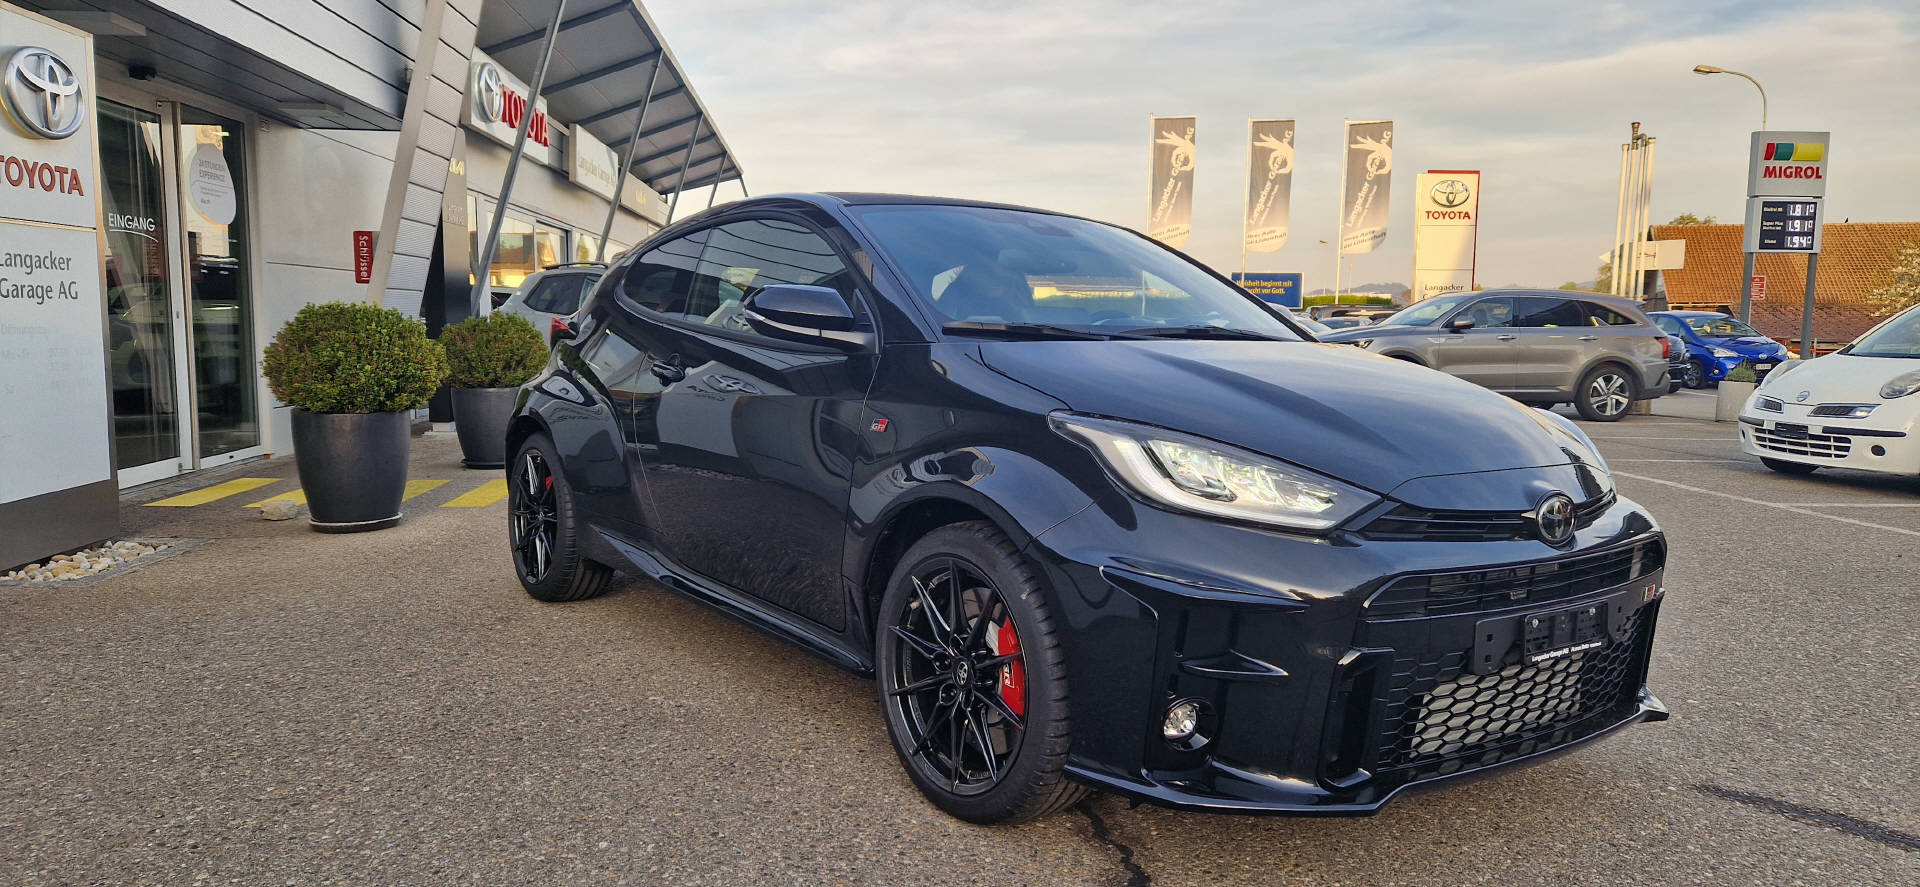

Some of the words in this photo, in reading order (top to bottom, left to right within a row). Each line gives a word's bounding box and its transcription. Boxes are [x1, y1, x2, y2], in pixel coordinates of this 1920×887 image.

[1762, 165, 1822, 180] MIGROL
[1152, 178, 1175, 223] Langacker
[1249, 180, 1272, 225] Langacker
[1345, 181, 1370, 227] Langacker
[108, 212, 156, 232] EINGANG
[1425, 211, 1471, 220] TOYOTA
[0, 250, 72, 275] angacker
[359, 235, 370, 280] Schlüssel
[0, 278, 53, 304] Garage
[58, 281, 78, 300] AG
[1424, 283, 1465, 292] Langacker
